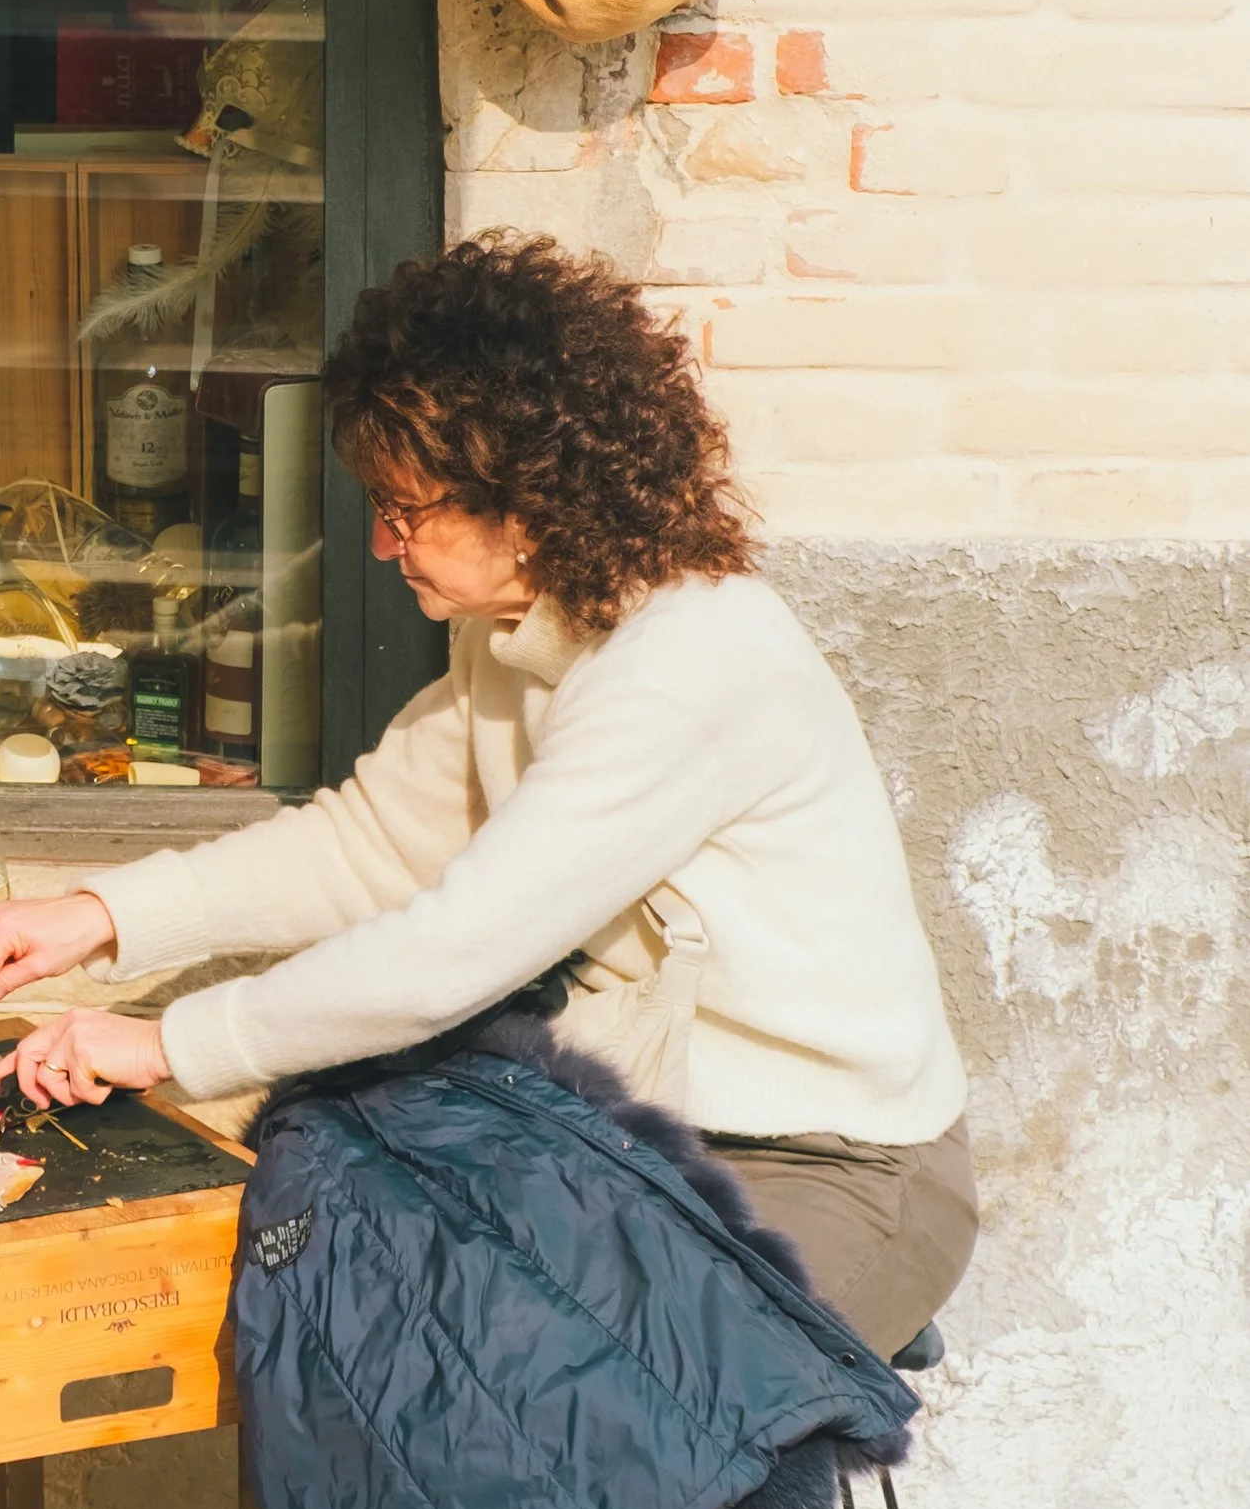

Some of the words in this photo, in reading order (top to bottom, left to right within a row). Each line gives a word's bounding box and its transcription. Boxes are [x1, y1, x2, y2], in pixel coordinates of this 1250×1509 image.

[141, 442, 155, 453] 12
[77, 1269, 144, 1290] TOSCANA
[3, 1281, 73, 1304] DIVERSITY
[60, 1290, 181, 1325] FRESCOBALDI
